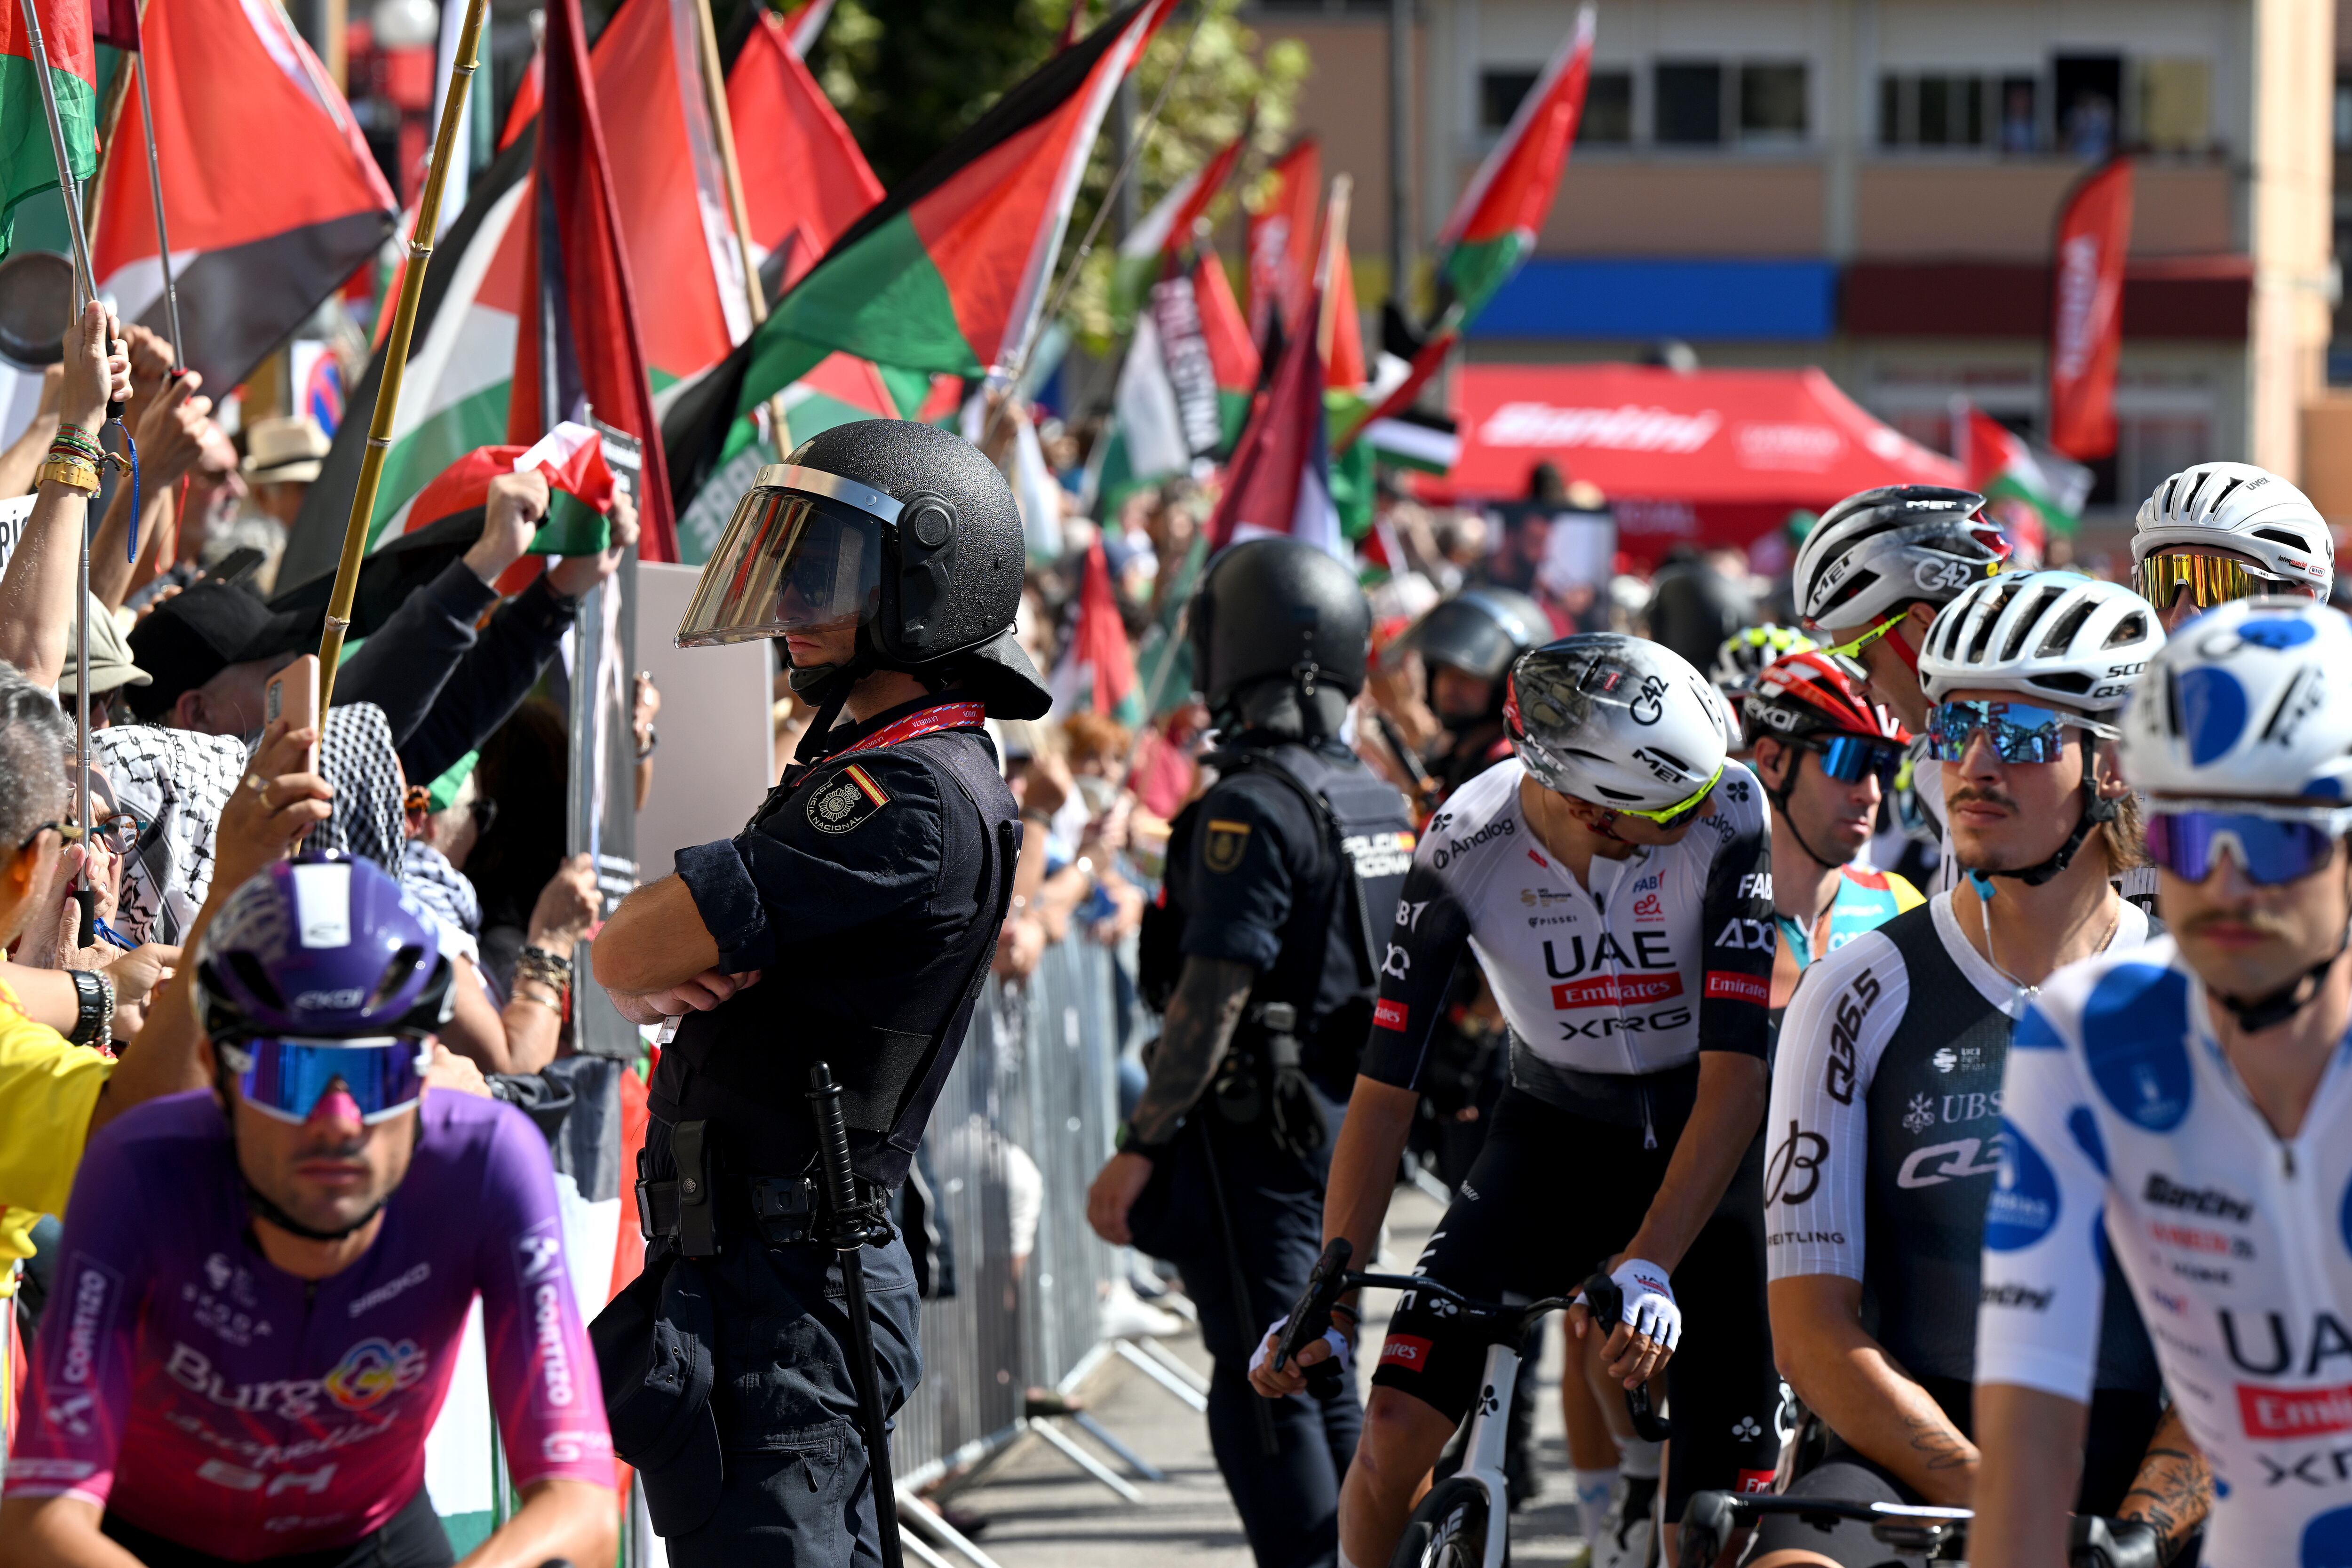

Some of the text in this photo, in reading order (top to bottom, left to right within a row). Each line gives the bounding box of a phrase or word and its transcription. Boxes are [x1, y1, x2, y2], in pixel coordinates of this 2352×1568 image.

[2246, 477, 2271, 491] uvex
[1906, 500, 1957, 509] MET
[1813, 551, 1853, 605] MET
[1914, 557, 1971, 592] G42
[2278, 555, 2307, 567] Intermarché
[1630, 676, 1669, 726] G42
[1526, 733, 1569, 772] MET
[1632, 749, 1688, 784] MET
[809, 782, 862, 831] POLICIA NACIONAL
[1452, 818, 1514, 859] Analog
[1540, 915, 1577, 925] PISSEI
[1543, 931, 1677, 979] UAE
[1565, 980, 1671, 1003] Emirates
[1710, 977, 1767, 999] Emirates
[1558, 1006, 1692, 1040] XRG
[1827, 968, 1880, 1106] Q36.5
[1942, 1090, 2003, 1124] UBS
[535, 1283, 573, 1406] CORTIZO
